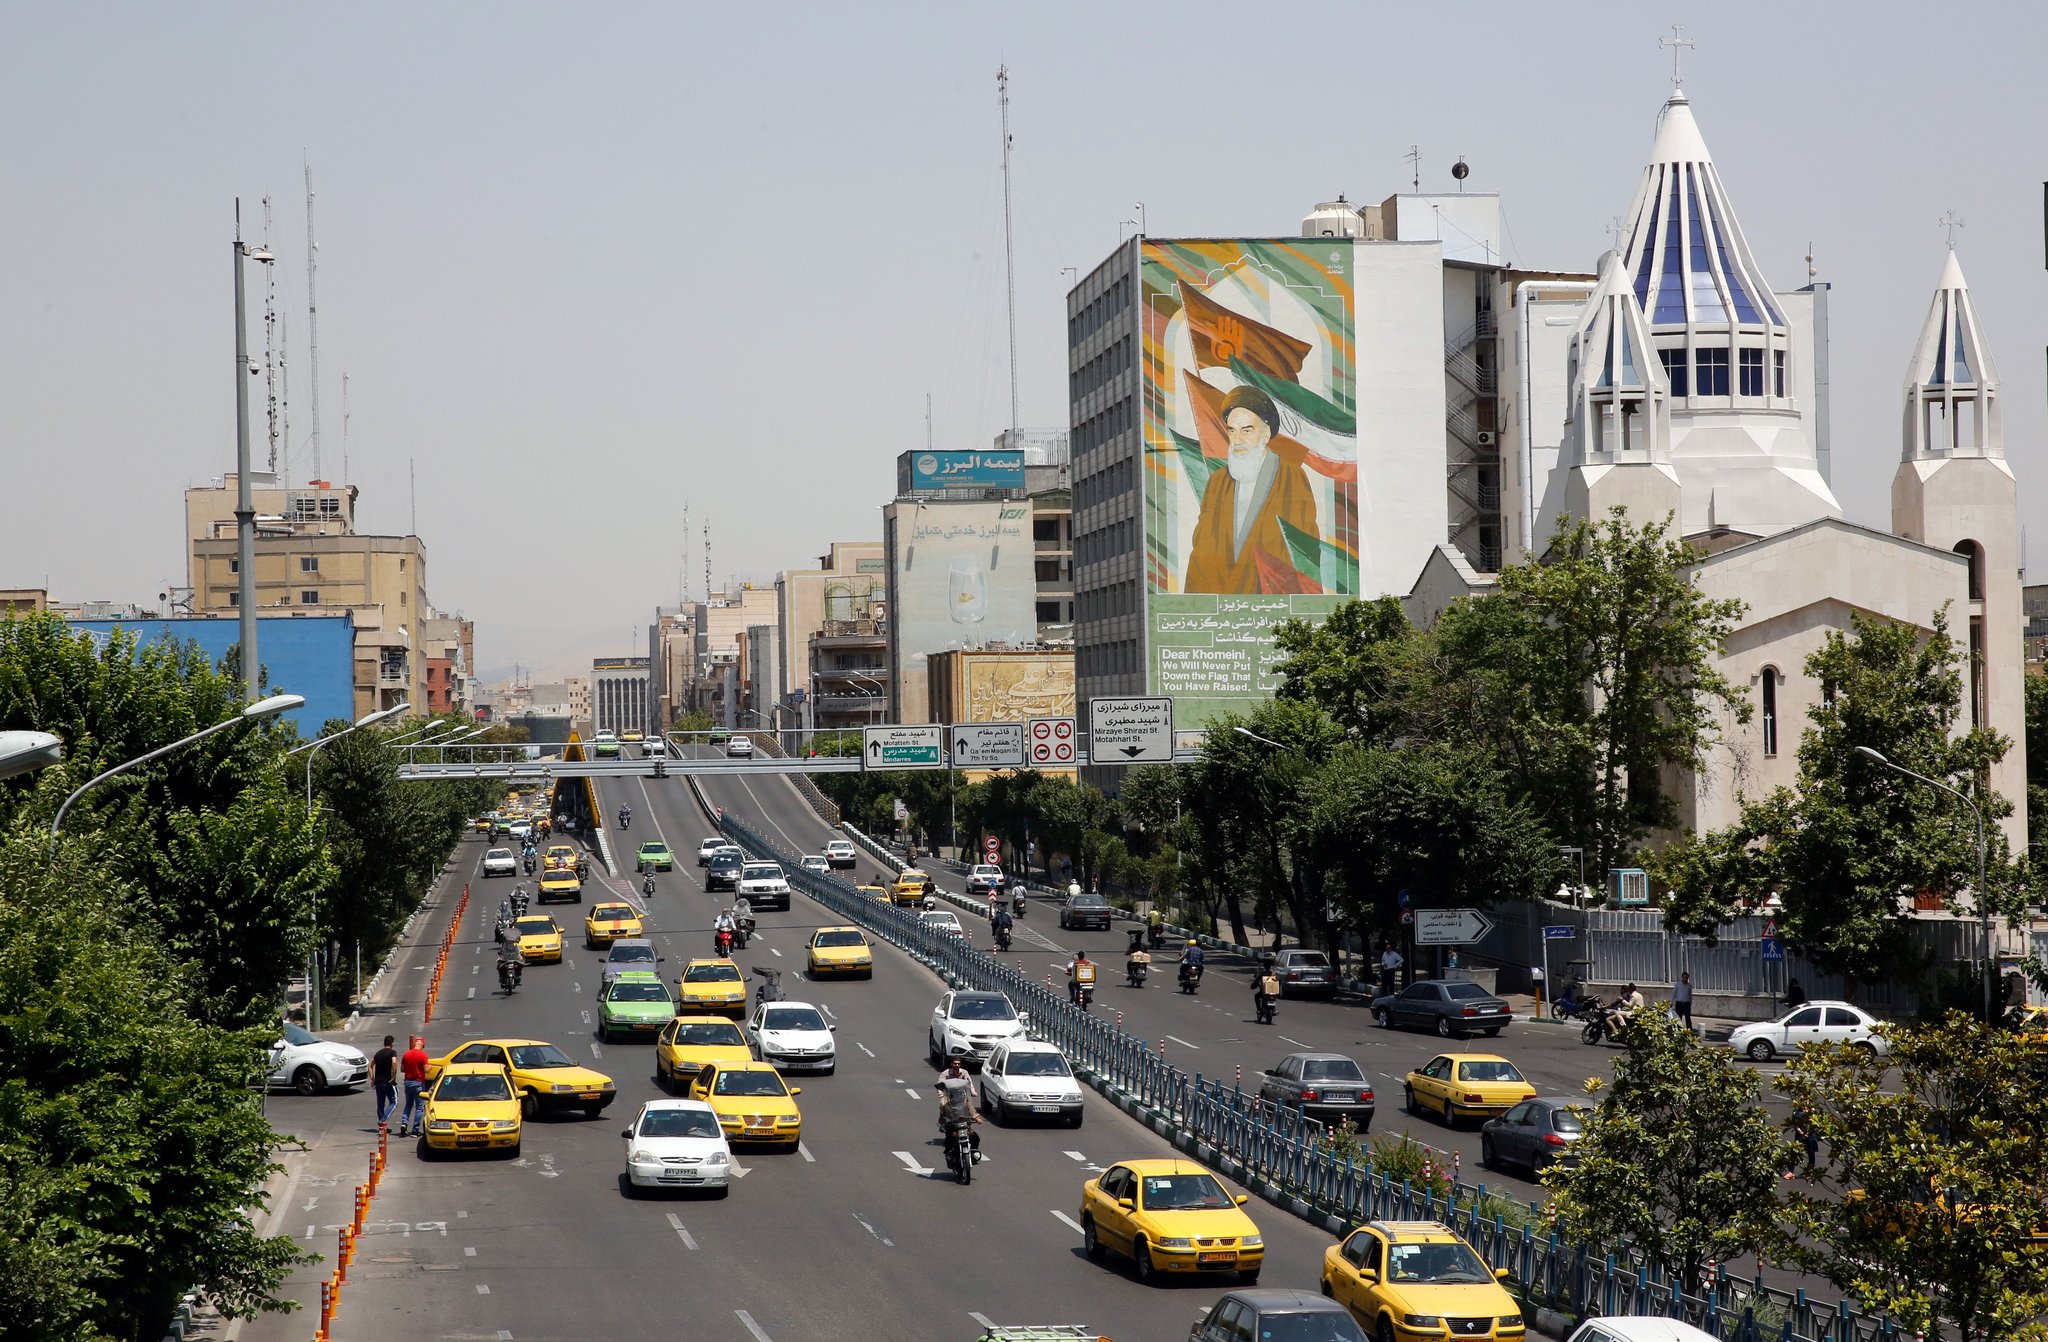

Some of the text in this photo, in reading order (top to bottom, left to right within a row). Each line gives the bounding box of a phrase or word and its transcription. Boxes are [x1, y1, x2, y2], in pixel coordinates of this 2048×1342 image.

[941, 455, 1021, 474] بیمه البرز
[1251, 598, 1288, 612] خمینی
[1161, 617, 1186, 630] زمین
[1187, 619, 1198, 631] به
[1198, 616, 1230, 630] هرگز
[1215, 630, 1256, 643] گذاشت
[1161, 648, 1190, 660] Dear
[1162, 660, 1178, 670] We
[1181, 661, 1199, 670] Will
[1202, 661, 1230, 670] Never
[1233, 661, 1251, 671] Put
[1162, 671, 1251, 683] Down the Flag That
[1163, 682, 1251, 692] You Have Raised.
[1097, 702, 1160, 713] میرزای شیرازی
[1105, 715, 1160, 727] شهید مطهری
[890, 730, 926, 740] شهید مفتح
[977, 728, 1010, 738] قائم مقام
[981, 739, 1010, 748] هفتم تیر
[884, 747, 928, 756] شهید مدرس
